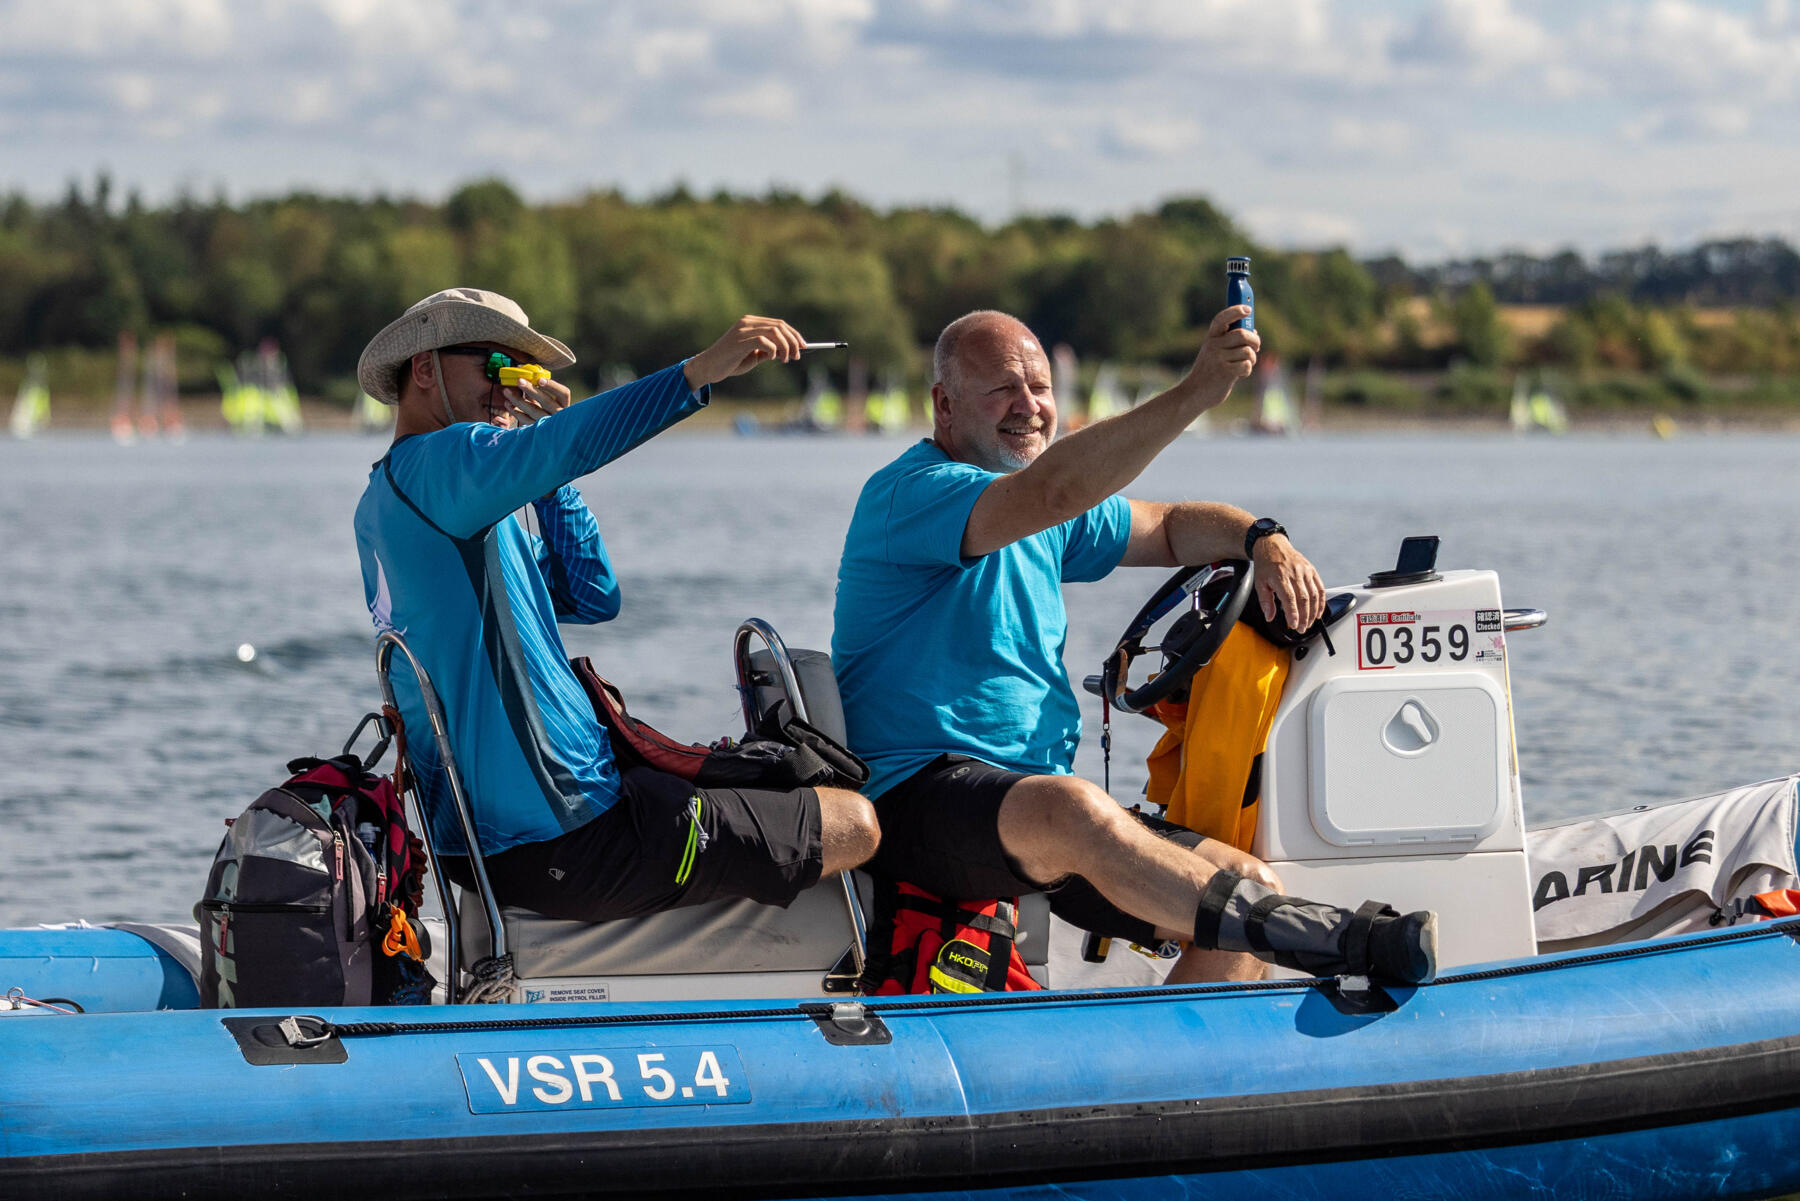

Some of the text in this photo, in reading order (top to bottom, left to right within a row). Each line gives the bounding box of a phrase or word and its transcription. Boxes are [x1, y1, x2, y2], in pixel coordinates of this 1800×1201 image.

[1391, 613, 1421, 622] Certificate
[1476, 622, 1501, 630] Checked
[1365, 624, 1469, 665] 0359
[1533, 830, 1715, 912] ARINE
[477, 1051, 731, 1105] VSR 5.4
